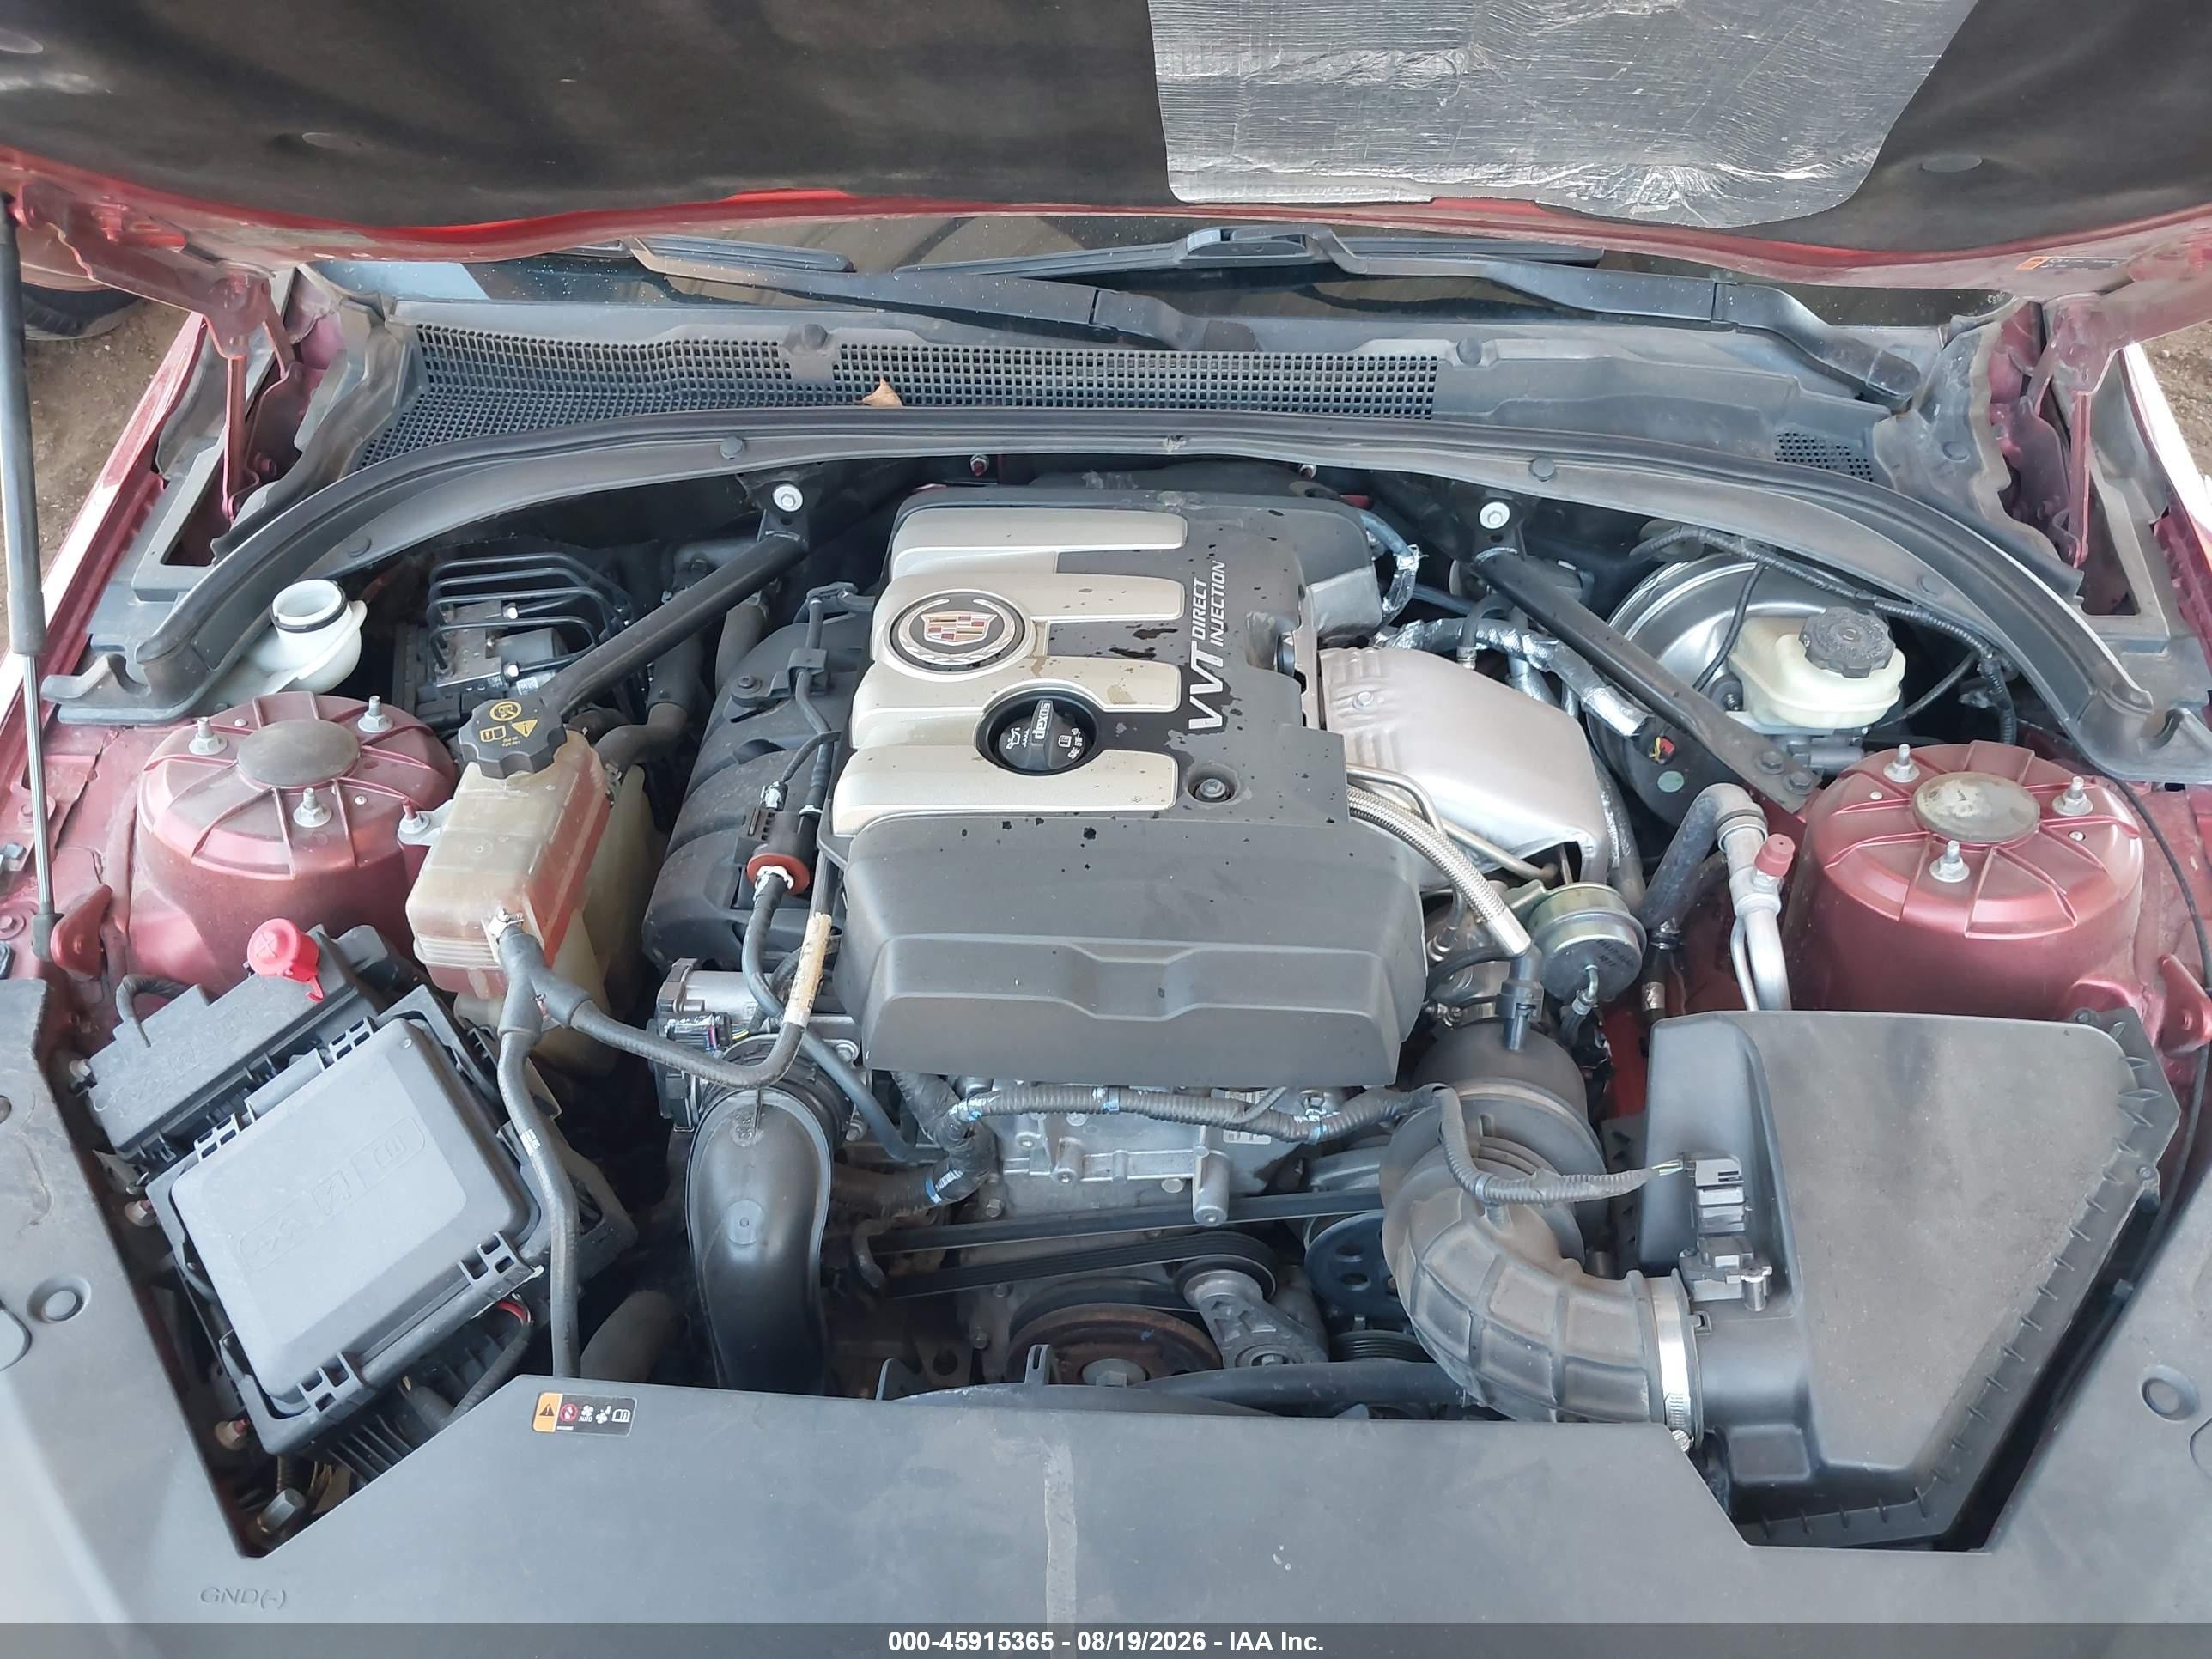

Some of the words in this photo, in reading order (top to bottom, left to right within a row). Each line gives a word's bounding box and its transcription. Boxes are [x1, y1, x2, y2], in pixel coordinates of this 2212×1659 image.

[1192, 576, 1207, 641] DIRECT
[1209, 560, 1226, 647] INJECTION
[1188, 640, 1224, 730] VVT
[1031, 702, 1051, 740] dexos
[578, 1415, 593, 1424] AUTO
